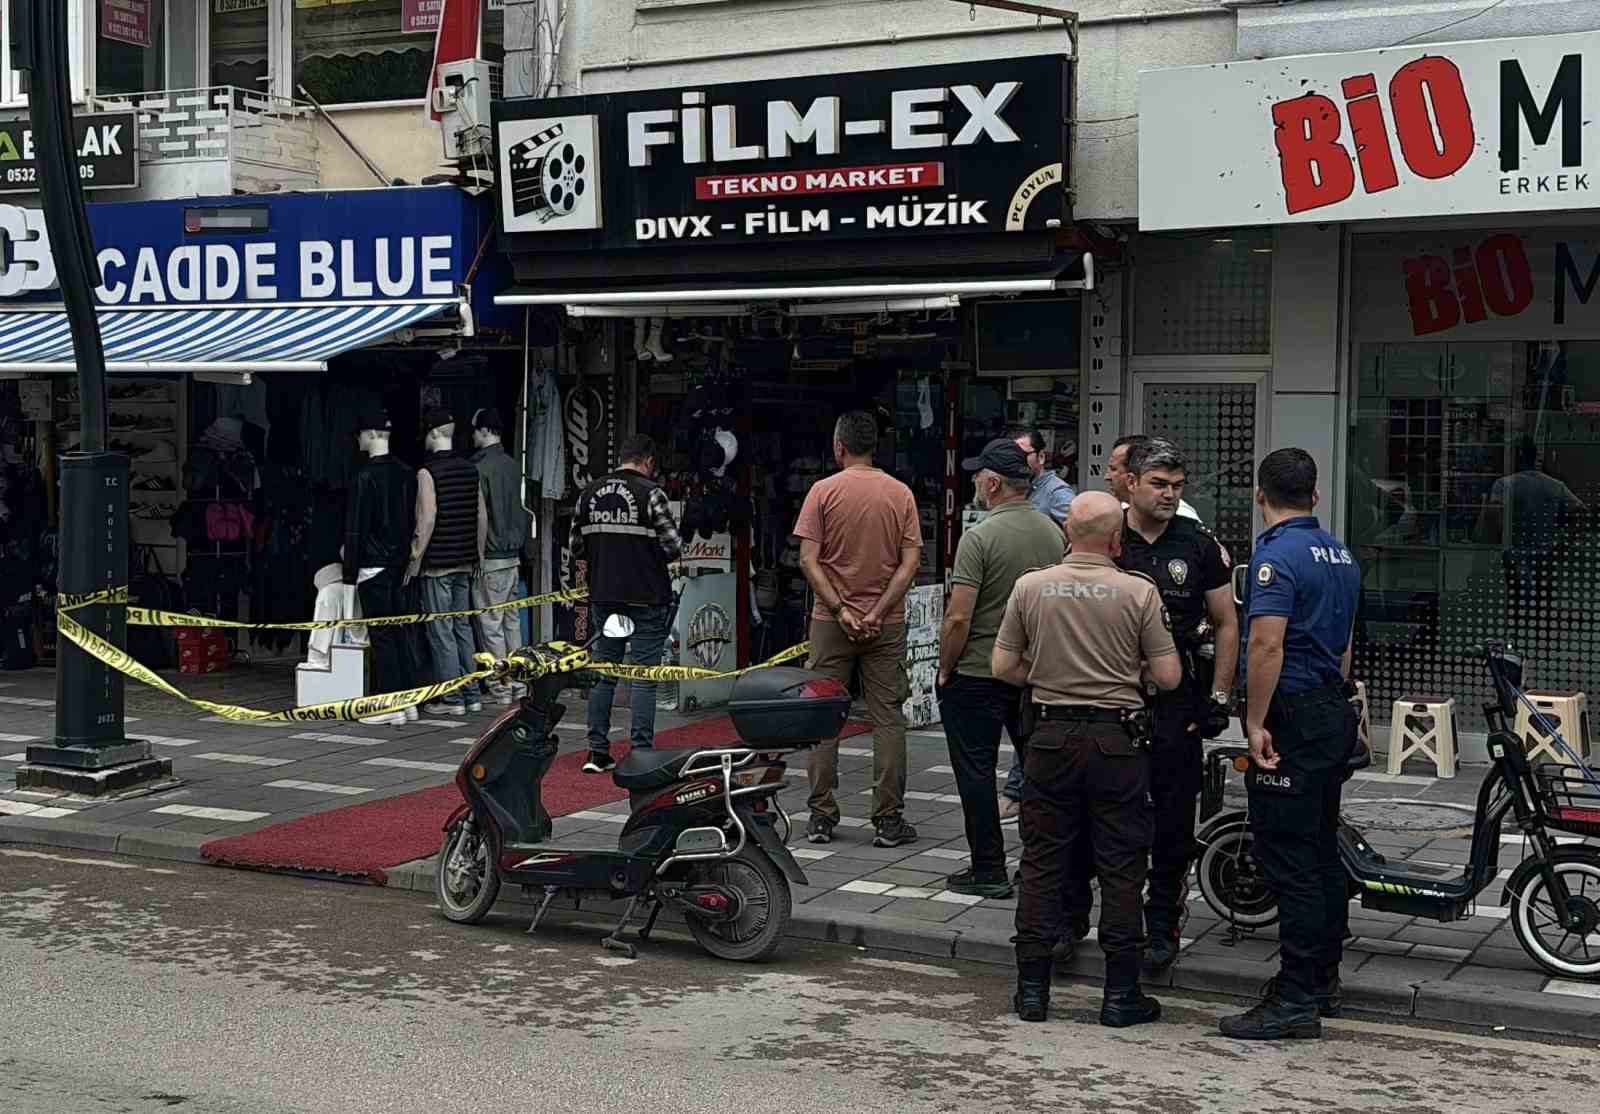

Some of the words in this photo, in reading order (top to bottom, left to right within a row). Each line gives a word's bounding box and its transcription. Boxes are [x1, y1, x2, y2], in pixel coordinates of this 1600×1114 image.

[23, 125, 122, 160] EAK
[628, 81, 1023, 167] FİLM-EX
[7, 168, 36, 182] 0532
[707, 174, 797, 195] TEKNO
[805, 167, 924, 190] MARKET
[1011, 203, 1024, 222] PC
[1021, 169, 1056, 199] OYUN
[1500, 173, 1589, 195] ERKEK
[635, 215, 713, 241] DIVX
[745, 204, 830, 235] FİLM
[866, 194, 989, 229] MÜZİK
[95, 242, 277, 304] CADDE
[300, 235, 453, 298] BLUE
